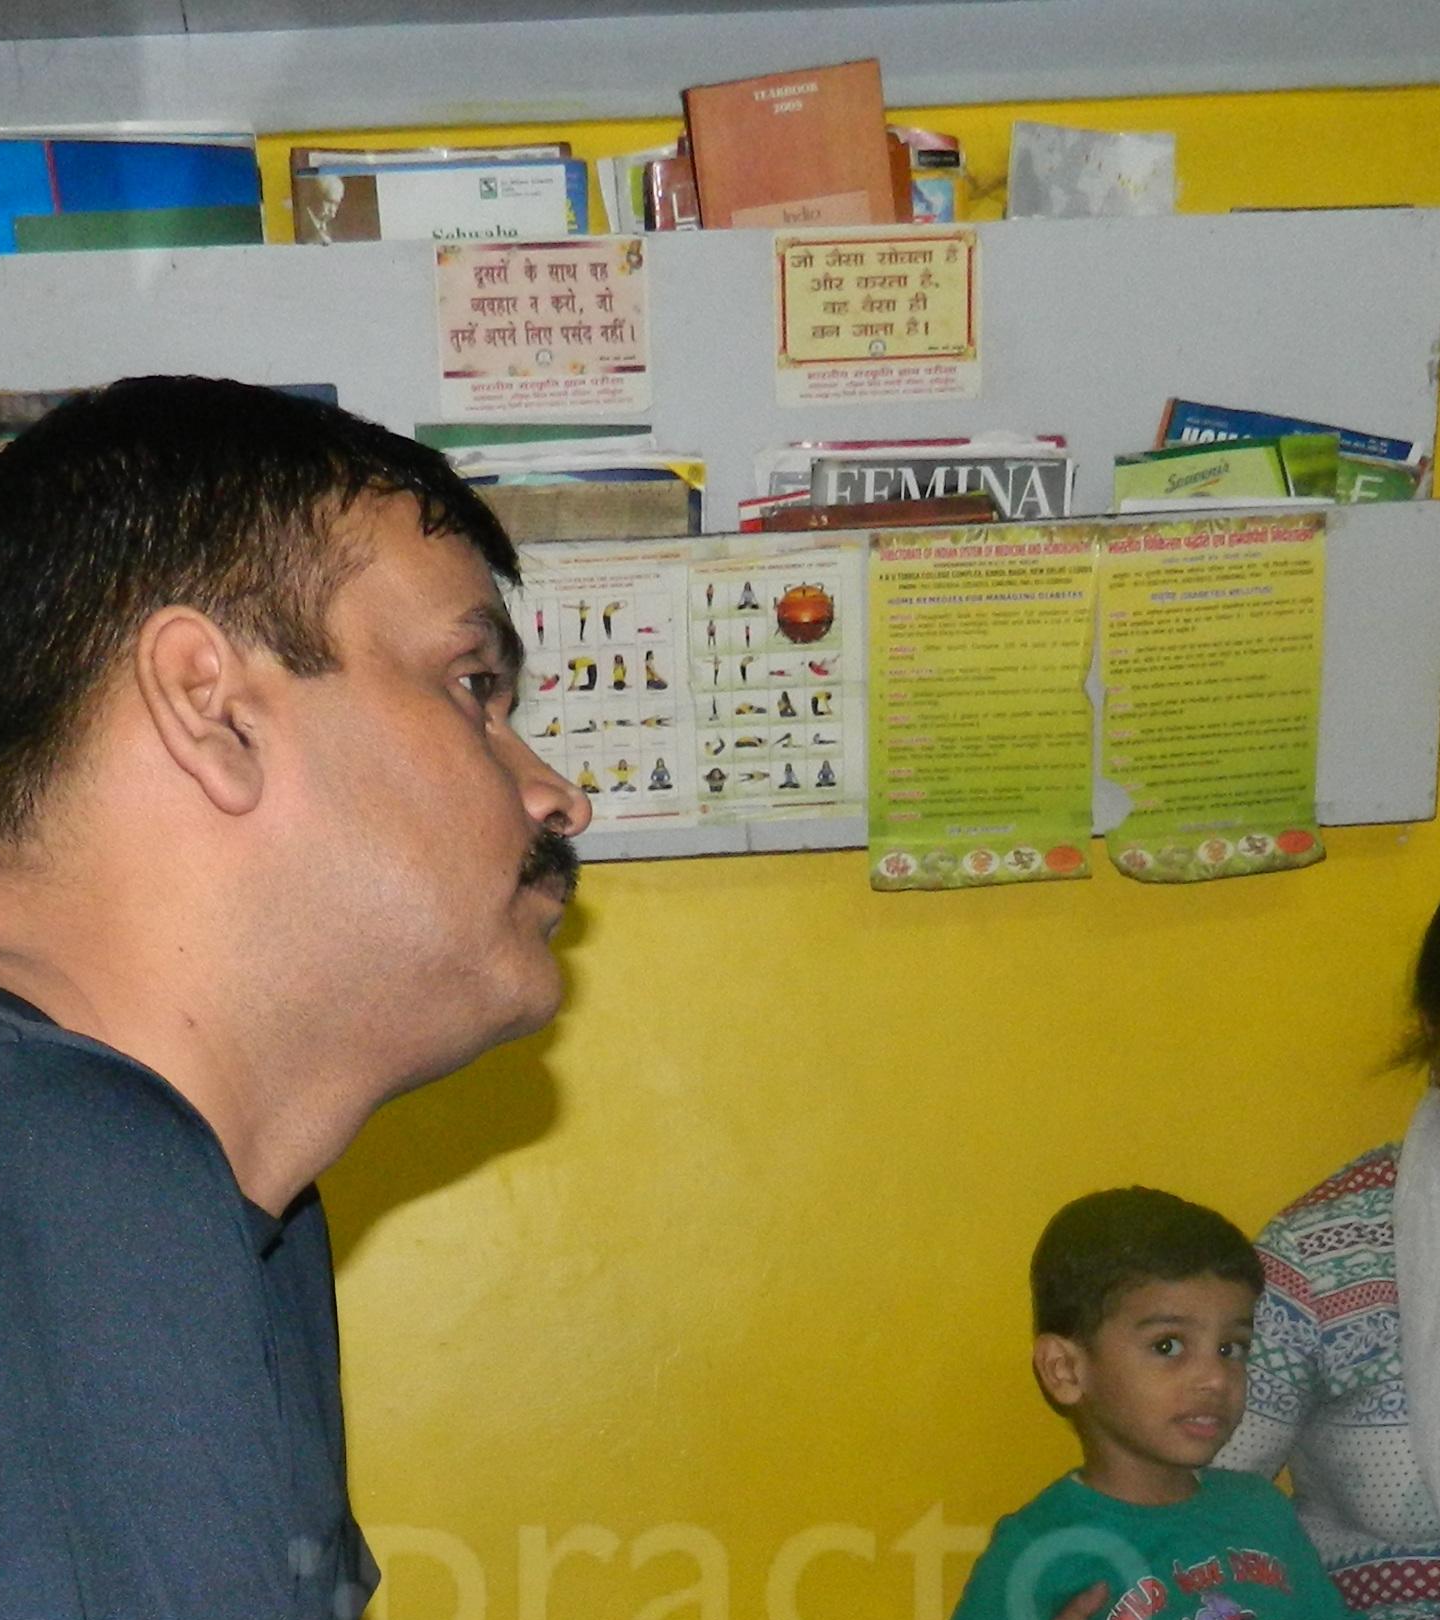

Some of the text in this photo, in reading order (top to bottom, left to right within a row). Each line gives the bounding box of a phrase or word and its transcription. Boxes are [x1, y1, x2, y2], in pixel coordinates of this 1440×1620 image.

[523, 257, 538, 283] के
[547, 263, 578, 283] साथ
[790, 248, 815, 268] जो
[529, 296, 539, 313] न
[596, 287, 614, 313] जो
